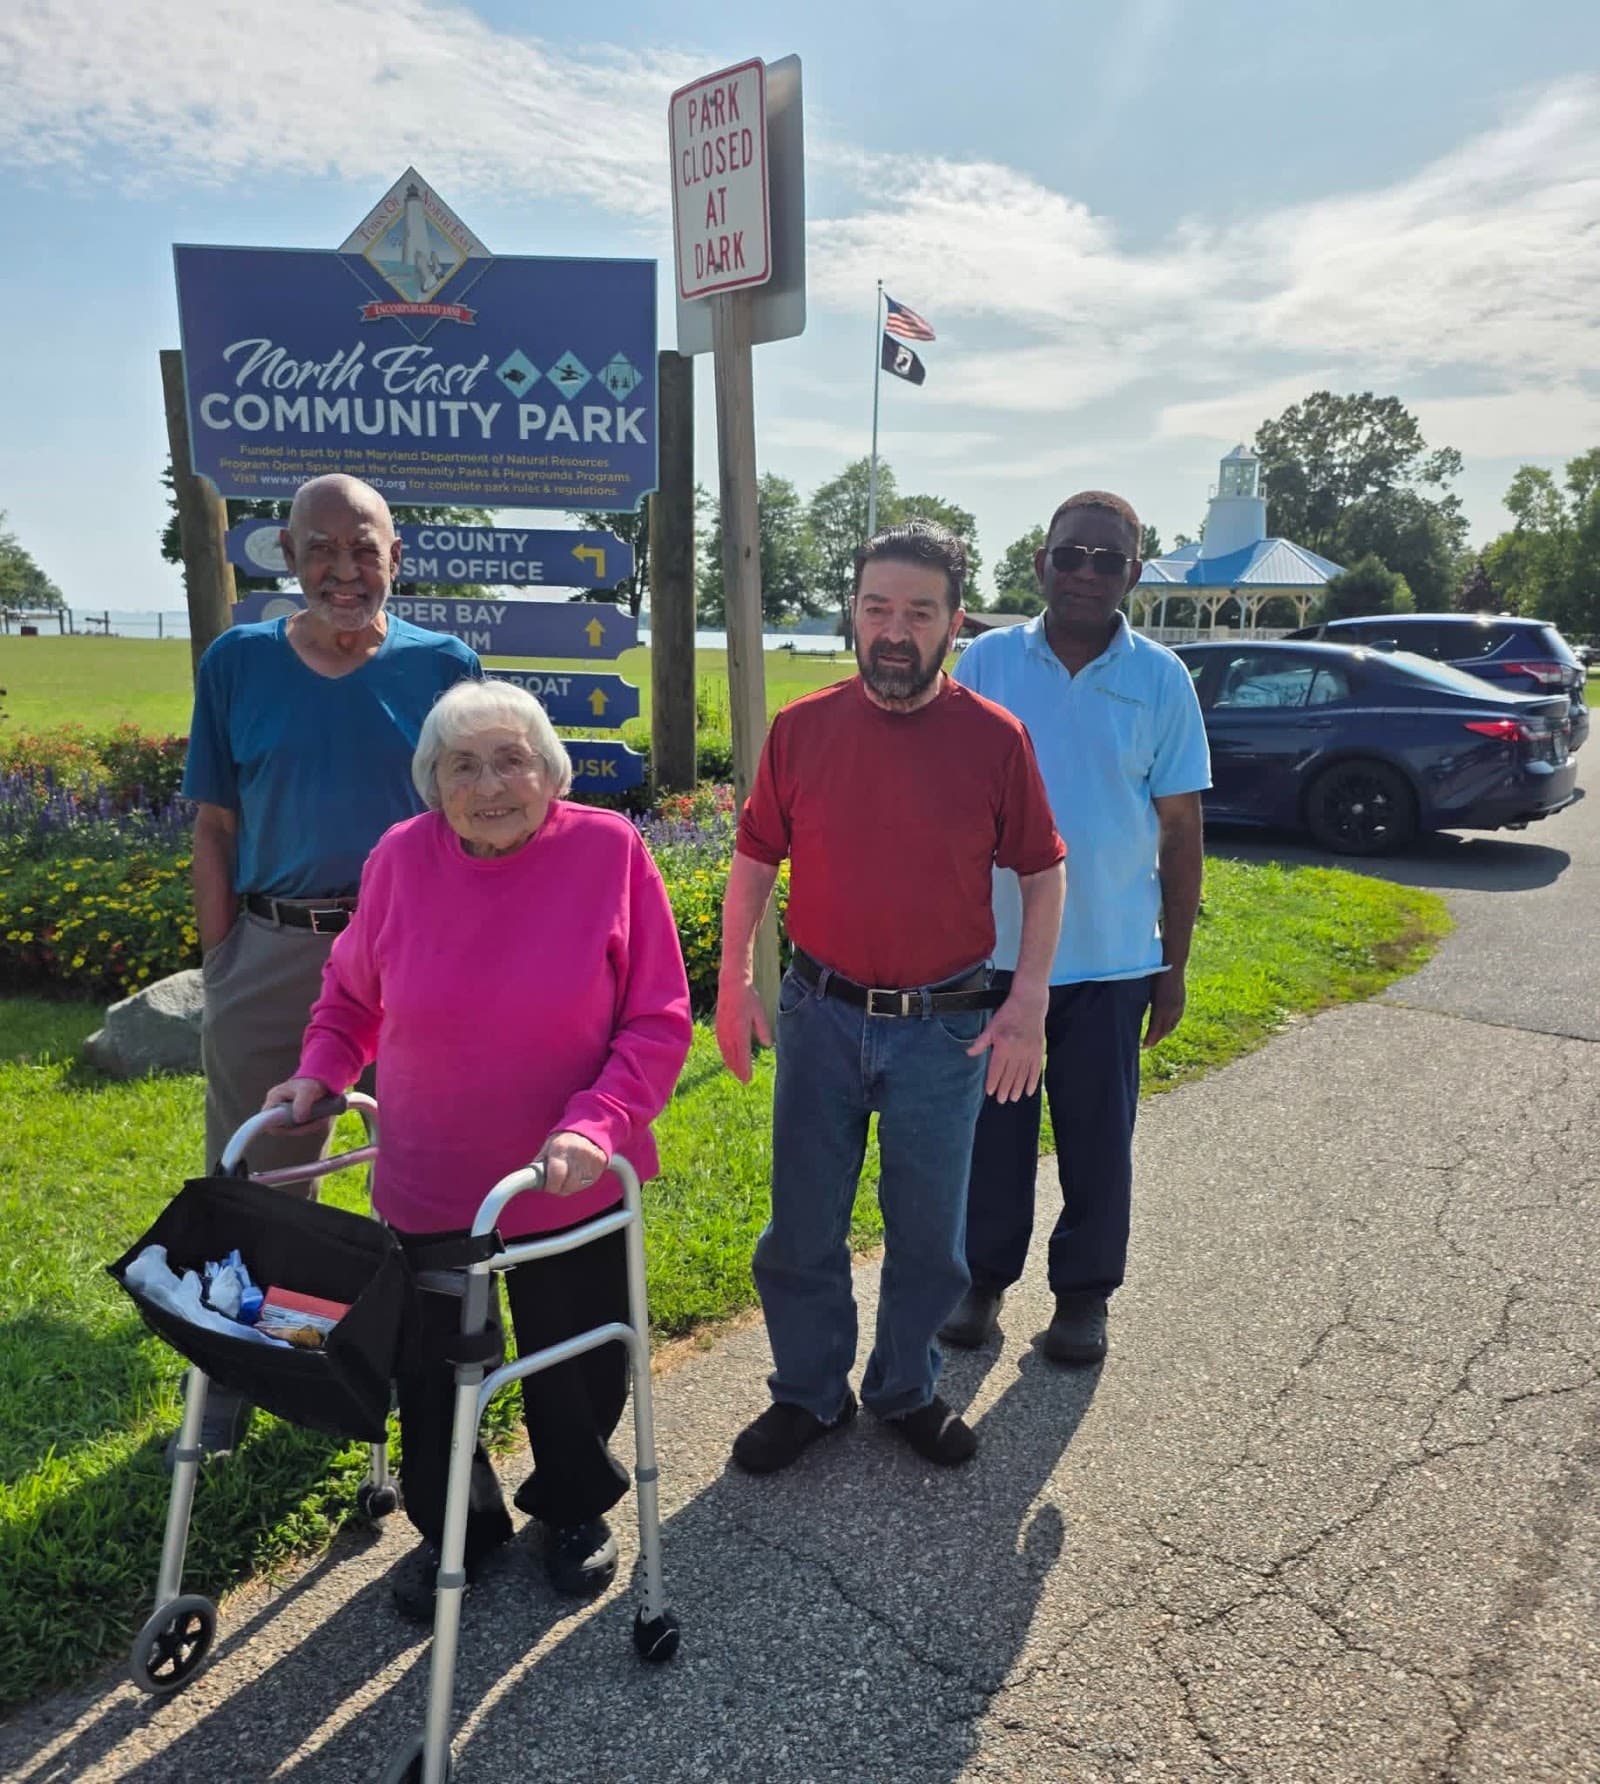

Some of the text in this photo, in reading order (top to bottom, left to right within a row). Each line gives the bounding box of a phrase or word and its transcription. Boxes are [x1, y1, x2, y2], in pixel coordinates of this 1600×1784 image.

[688, 82, 740, 136] PARK
[682, 128, 753, 187] CLOSED
[705, 187, 727, 229] AT
[695, 231, 746, 280] DARK
[223, 338, 490, 395] North East
[200, 392, 648, 444] COMMUNITY PARK
[240, 445, 609, 468] Funded in part by the Maryland Department of Natural Resources
[220, 458, 631, 484] Program Open Space and the Community Parks & Playgrounds Programs
[231, 472, 257, 483] Visit
[409, 478, 424, 489] for
[428, 481, 482, 493] complete
[485, 481, 510, 494] park
[513, 483, 539, 494] rules
[543, 484, 550, 494] &
[418, 531, 529, 553] COUNTY
[446, 558, 545, 581] OFFICE
[456, 605, 508, 625] BAY
[511, 675, 572, 696] BOAT
[572, 759, 618, 778] USK
